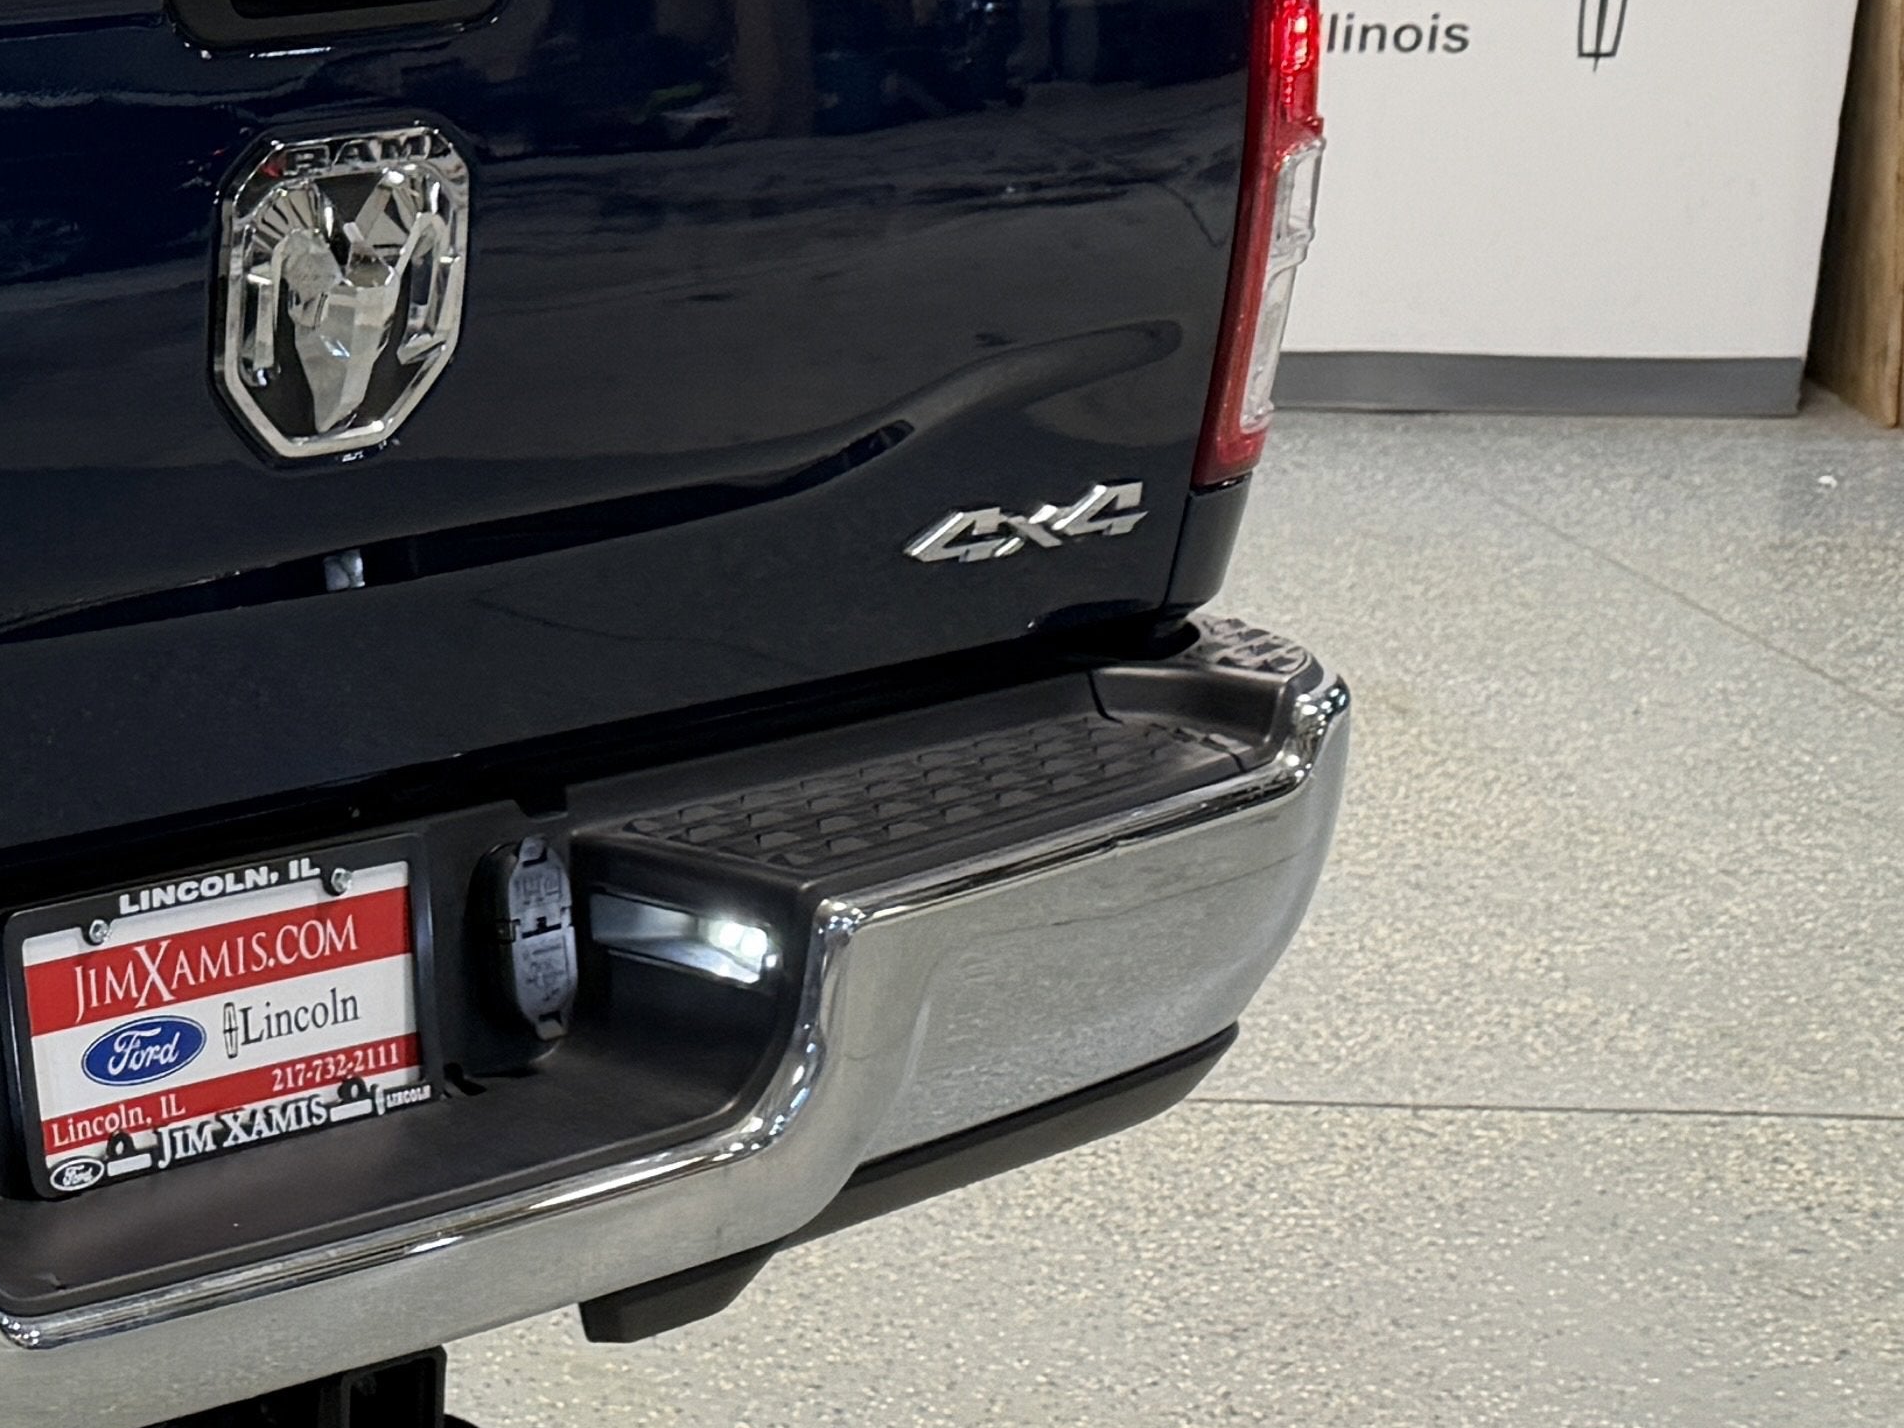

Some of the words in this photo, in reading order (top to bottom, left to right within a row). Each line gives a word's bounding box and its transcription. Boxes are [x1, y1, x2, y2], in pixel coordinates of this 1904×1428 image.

[1319, 12, 1470, 55] linois
[282, 134, 431, 178] RAM
[119, 866, 279, 915] LINCOLN,
[288, 858, 321, 880] IL
[73, 914, 359, 1022] JIMXAMIS.COM
[239, 987, 360, 1046] Lincoln
[107, 1027, 181, 1076] Ford
[272, 1042, 400, 1092] 217-732-2111
[52, 1103, 153, 1147] Lincoln,
[160, 1093, 186, 1120] IL
[157, 1126, 217, 1169] JIM
[221, 1095, 328, 1148] XAMIS
[62, 1164, 94, 1187] Ford
